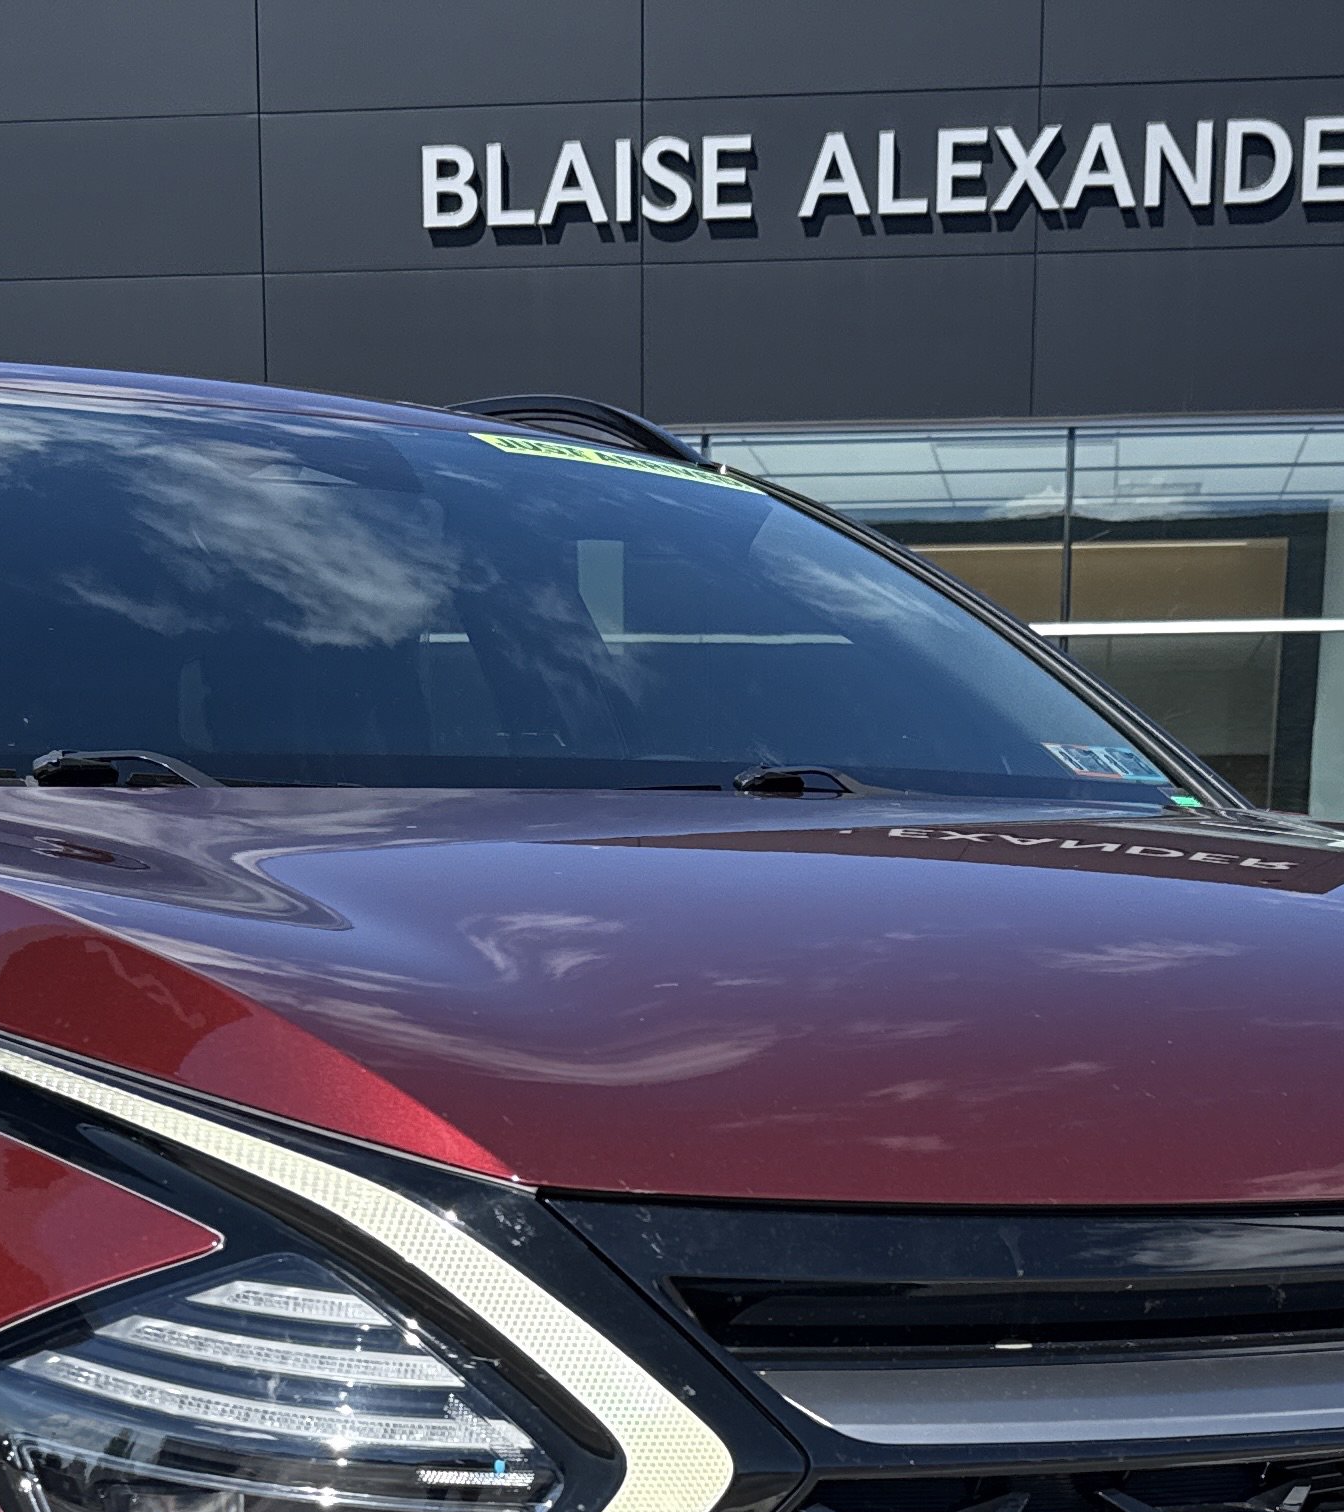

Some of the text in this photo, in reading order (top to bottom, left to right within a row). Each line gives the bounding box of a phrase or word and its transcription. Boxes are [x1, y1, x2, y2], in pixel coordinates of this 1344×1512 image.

[420, 134, 754, 229] BLAISE
[495, 438, 744, 488] JUST ARRIVED
